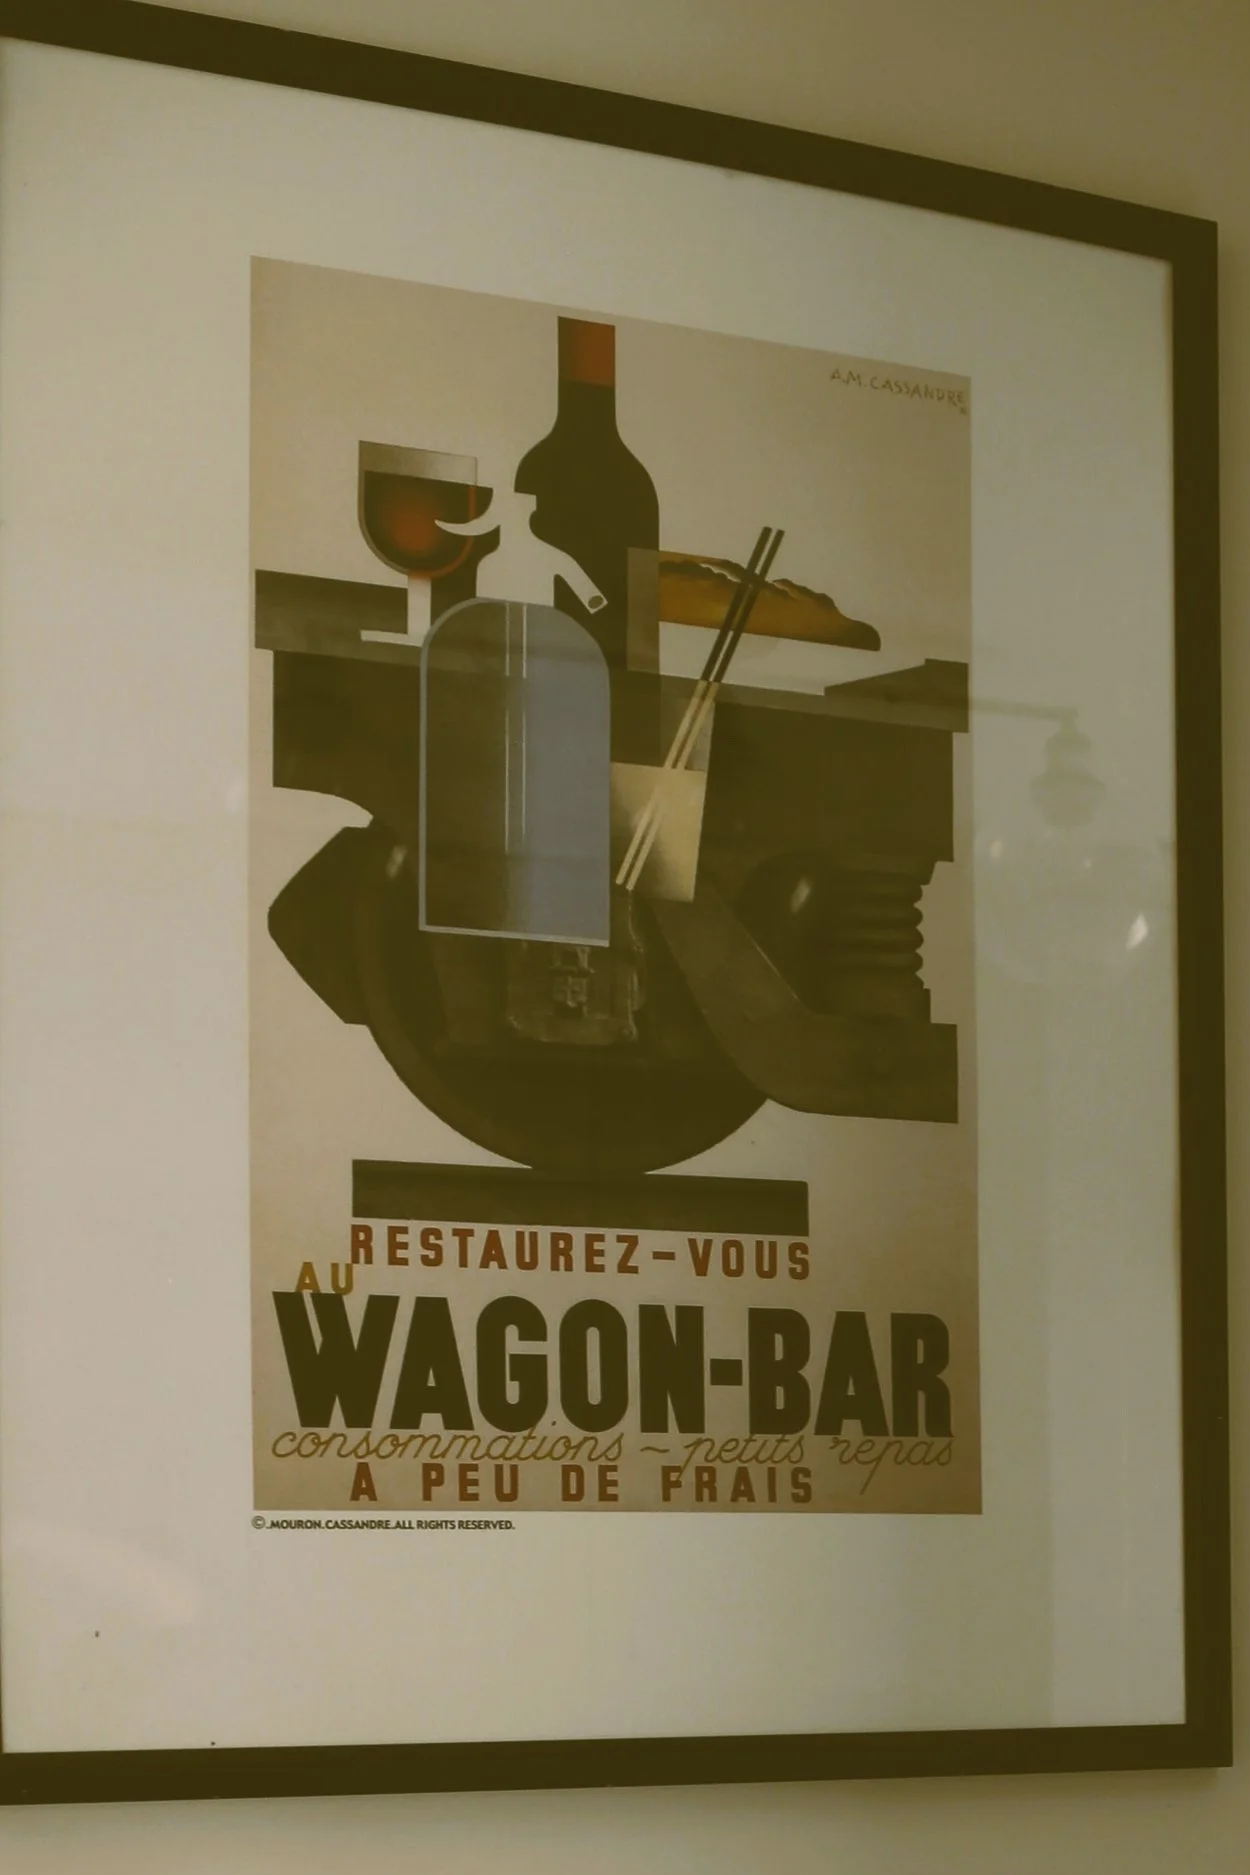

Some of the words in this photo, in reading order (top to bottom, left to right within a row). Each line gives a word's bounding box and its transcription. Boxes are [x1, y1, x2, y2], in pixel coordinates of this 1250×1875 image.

[350, 1224, 812, 1280] RESTAUREZ-VOUS
[295, 1261, 354, 1295] AU
[271, 1291, 955, 1438] WAGON-BAR
[271, 1425, 625, 1462] consommations
[677, 1432, 805, 1483] petits
[828, 1435, 955, 1496] repas
[349, 1461, 378, 1502] A
[421, 1462, 520, 1503] PEU
[560, 1464, 620, 1503] DE
[660, 1465, 813, 1504] FRAIS
[416, 1519, 457, 1530] RIGHTS
[457, 1519, 516, 1530] RESERVED.
